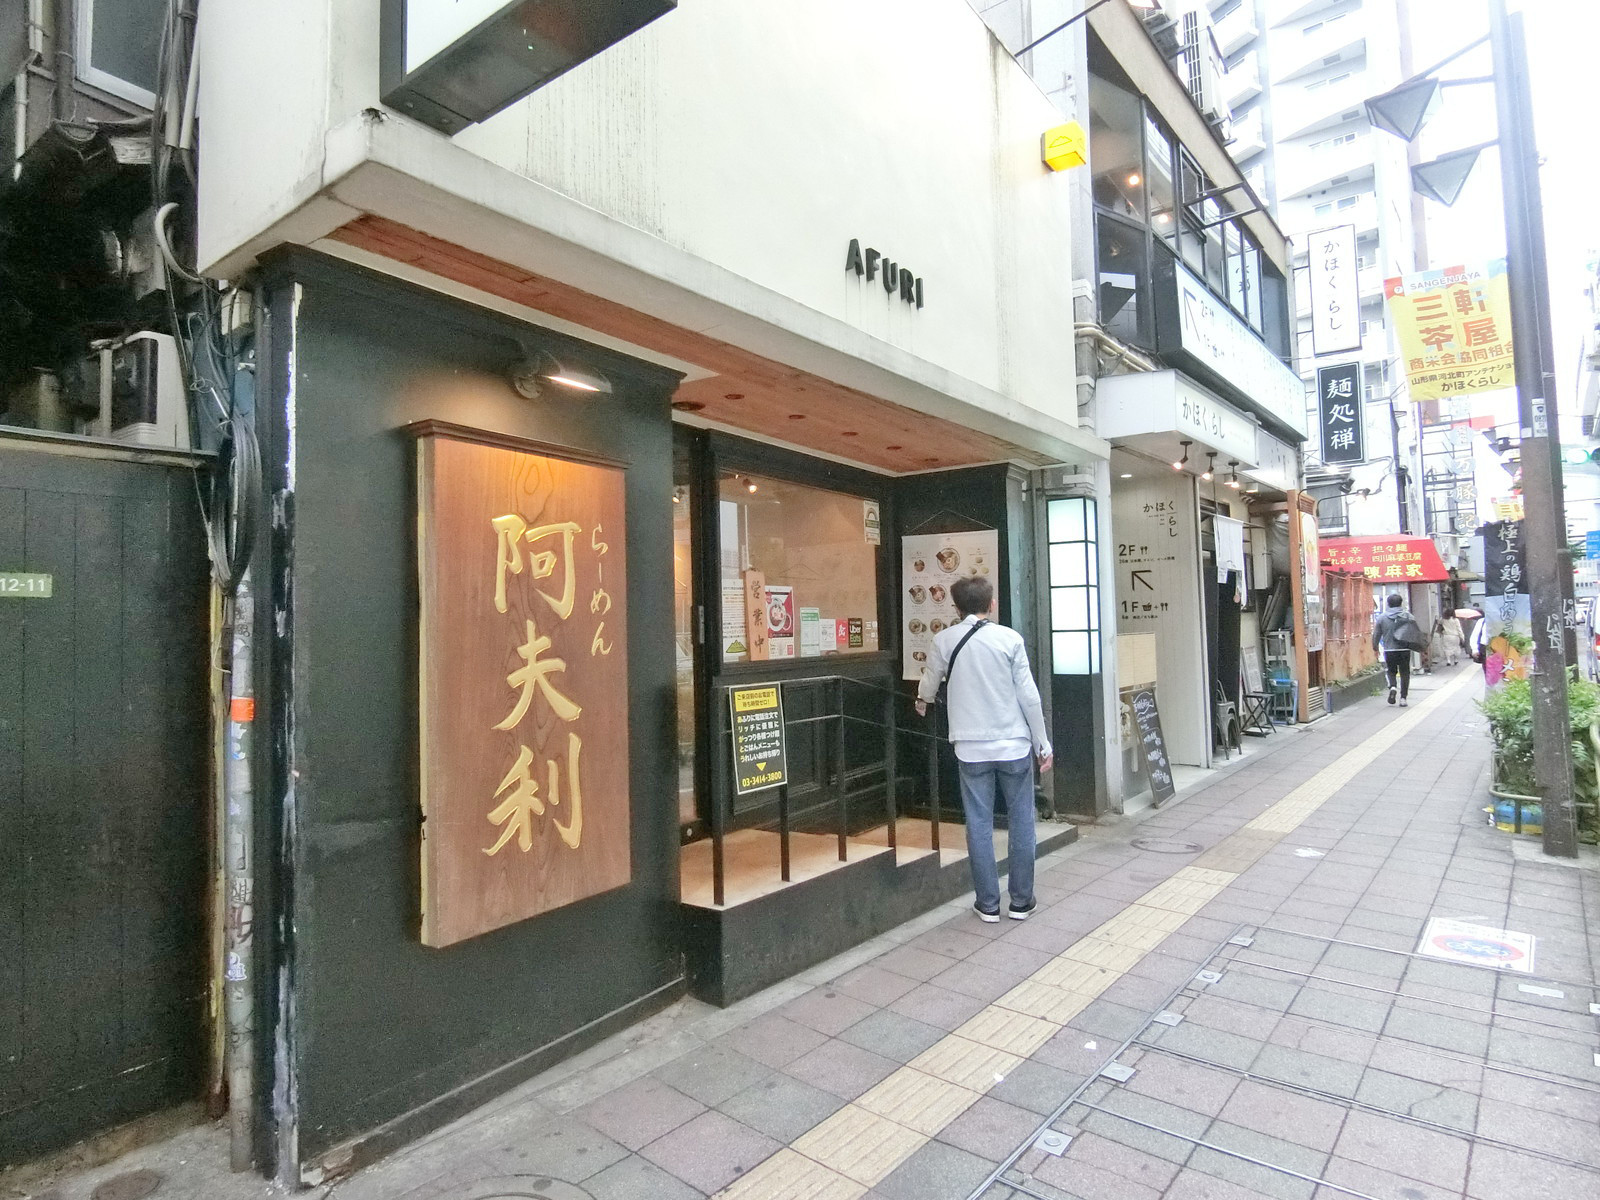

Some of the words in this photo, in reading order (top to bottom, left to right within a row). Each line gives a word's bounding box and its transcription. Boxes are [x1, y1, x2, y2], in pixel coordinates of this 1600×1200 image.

[845, 238, 923, 310] AFURI
[1409, 271, 1481, 291] SANGENJAYA
[1323, 240, 1342, 330] かほくらし
[1441, 375, 1500, 392] かほくらし
[1182, 396, 1225, 439] かほくらし
[1326, 378, 1355, 450] 麺処禅
[1118, 544, 1136, 556] 2F
[1371, 543, 1408, 554] 担々麺
[0, 577, 45, 592] 12-11
[590, 523, 613, 657] らーめん
[1121, 600, 1139, 613] 1F
[750, 580, 765, 654] 営業中
[849, 625, 862, 634] Uber
[481, 513, 583, 857] 阿夫利
[742, 771, 782, 788] 03-3414-3800
